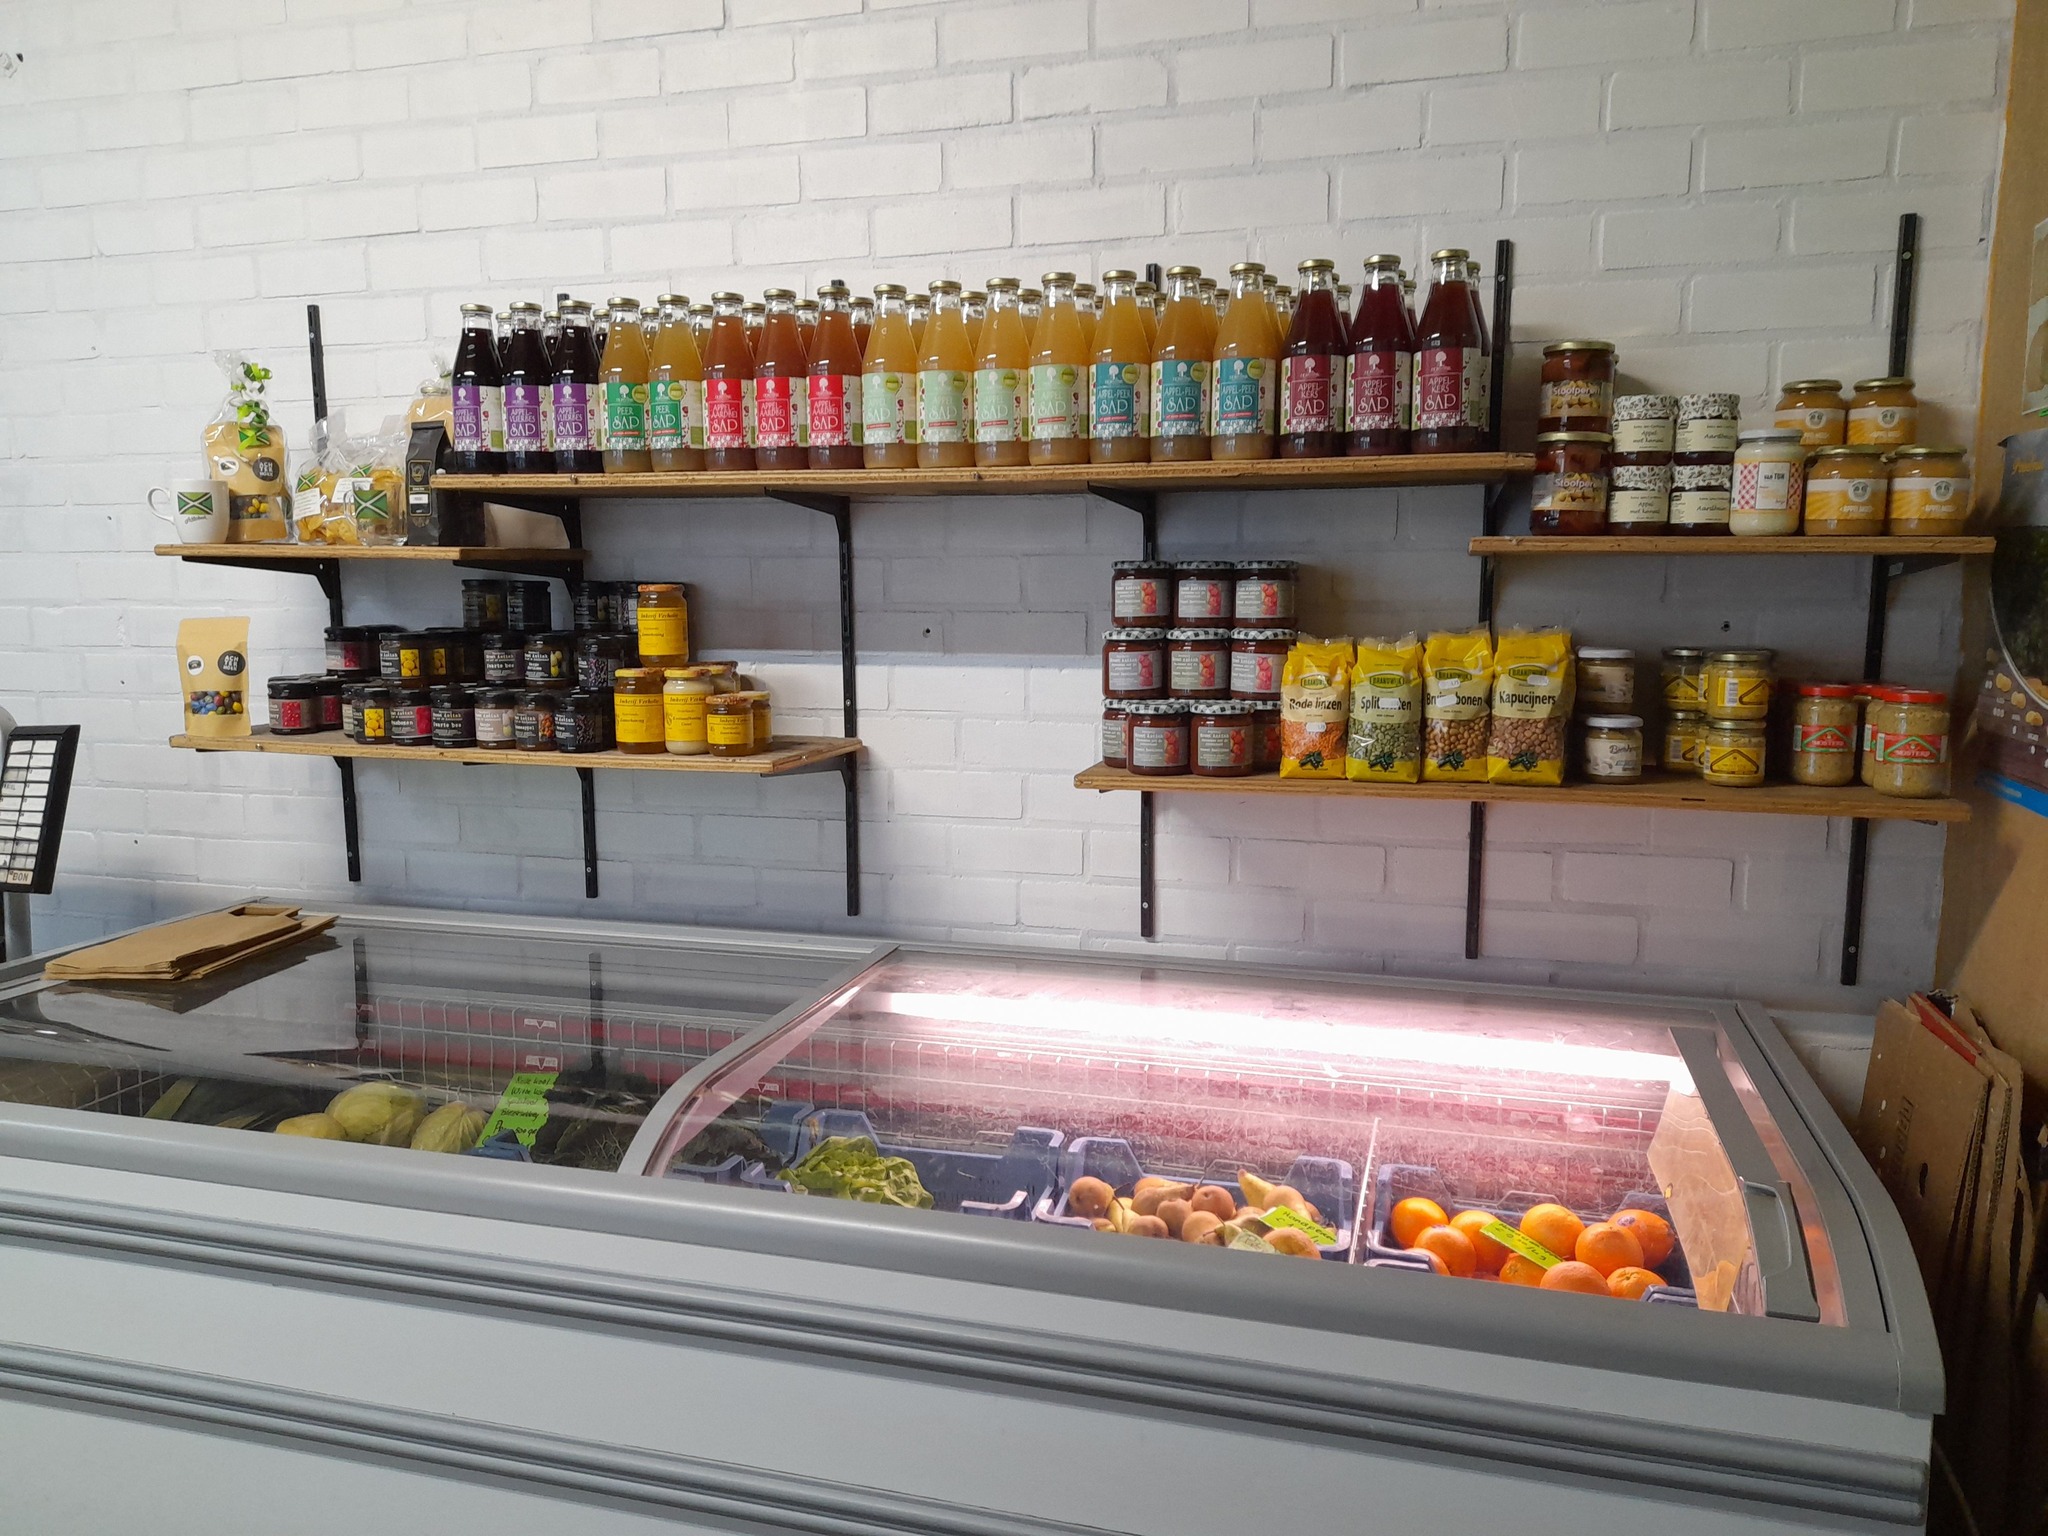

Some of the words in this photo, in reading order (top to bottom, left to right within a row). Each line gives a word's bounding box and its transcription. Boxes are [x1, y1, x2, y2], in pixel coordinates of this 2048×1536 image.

[1301, 390, 1318, 399] KERS
[1365, 387, 1383, 396] KERS
[1431, 384, 1449, 394] KERS
[1038, 401, 1066, 416] SAP
[1100, 400, 1128, 414] SAP
[1166, 397, 1196, 412] SAP
[1223, 395, 1253, 409] SAP
[1294, 400, 1325, 415] SAP
[1358, 397, 1389, 414] SAP
[1424, 394, 1456, 410] SAP
[617, 407, 633, 415] PEER
[655, 405, 670, 414] PEER
[867, 407, 891, 421] SAP
[929, 406, 957, 419] SAP
[982, 405, 1008, 419] SAP
[613, 416, 640, 429] SAP
[653, 414, 676, 428] SAP
[712, 419, 738, 432] SAP
[760, 418, 785, 431] SAP
[813, 416, 838, 430] SAP
[455, 424, 476, 437] SAP
[510, 424, 535, 437] SAP
[558, 422, 583, 436] SAP
[1290, 698, 1312, 710] Rode
[1315, 698, 1342, 710] linzen
[1361, 696, 1412, 712] Splitten
[1455, 692, 1482, 706] bonen
[1499, 691, 1556, 708] Kapucijners
[13, 873, 29, 882] BON
